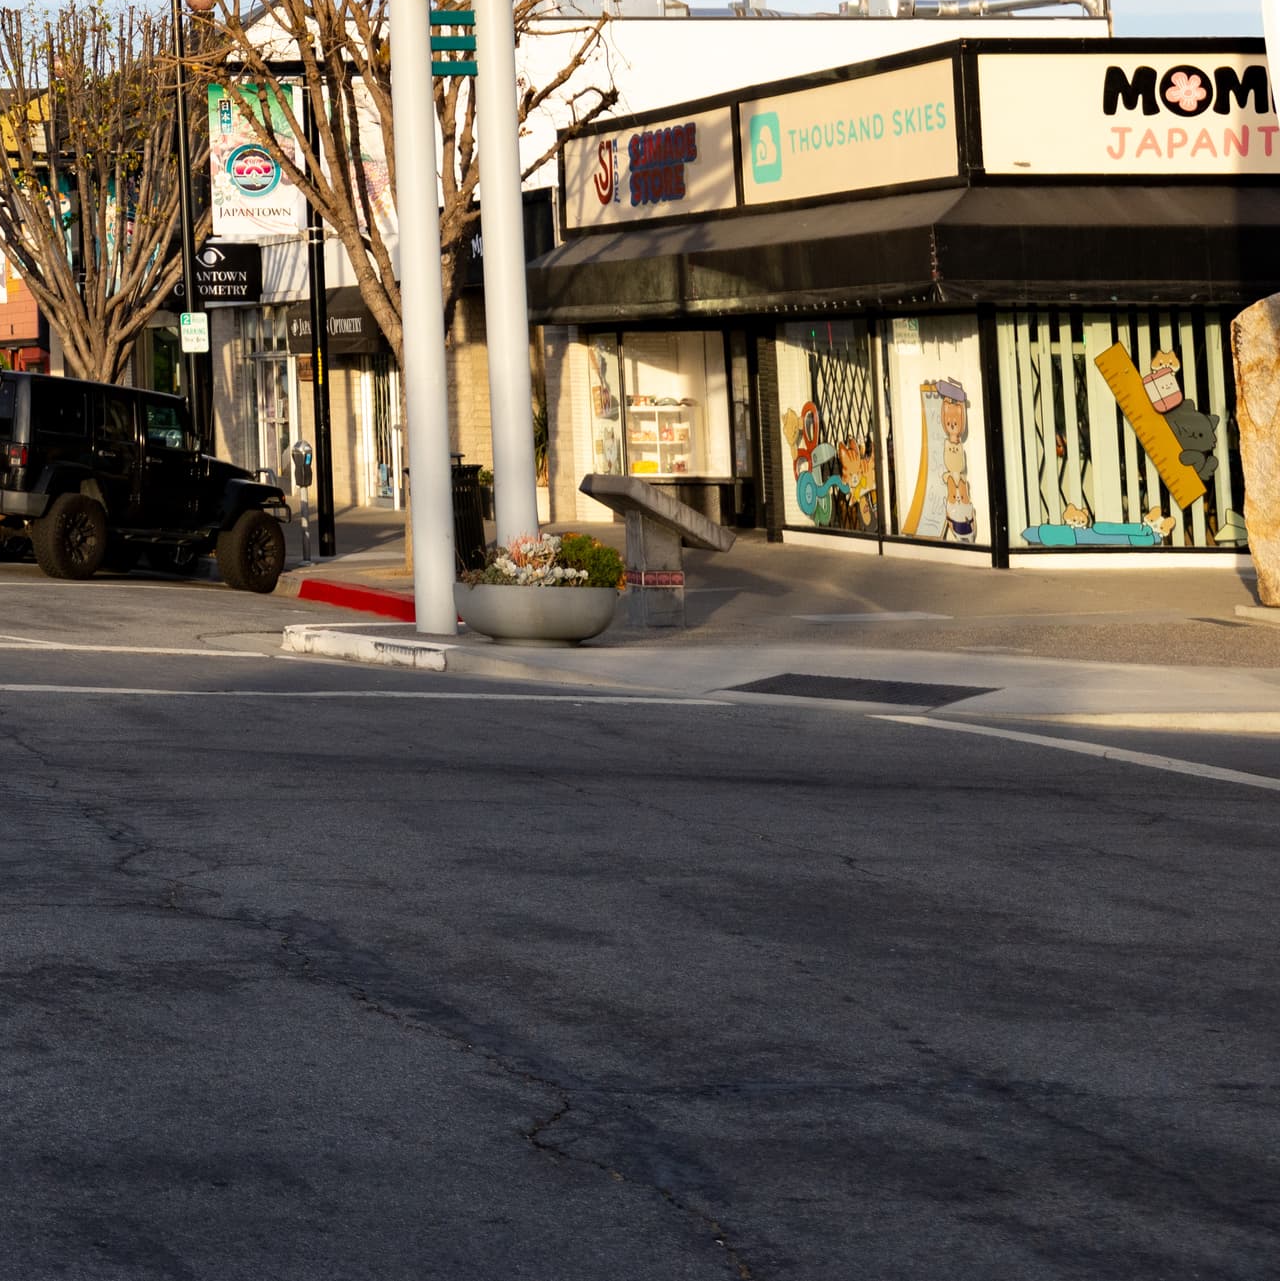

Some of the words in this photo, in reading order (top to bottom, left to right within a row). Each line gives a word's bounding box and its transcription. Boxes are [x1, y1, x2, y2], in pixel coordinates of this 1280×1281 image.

[1103, 65, 1277, 118] MOM
[787, 113, 885, 155] THOUSAND
[892, 102, 947, 138] SKIES
[612, 138, 620, 204] MADE
[630, 163, 686, 207] STORE
[219, 207, 291, 218] JAPANTOWN
[174, 284, 248, 296] OOMETRY
[184, 315, 191, 325] 2
[329, 316, 362, 336] OPTOMETRY
